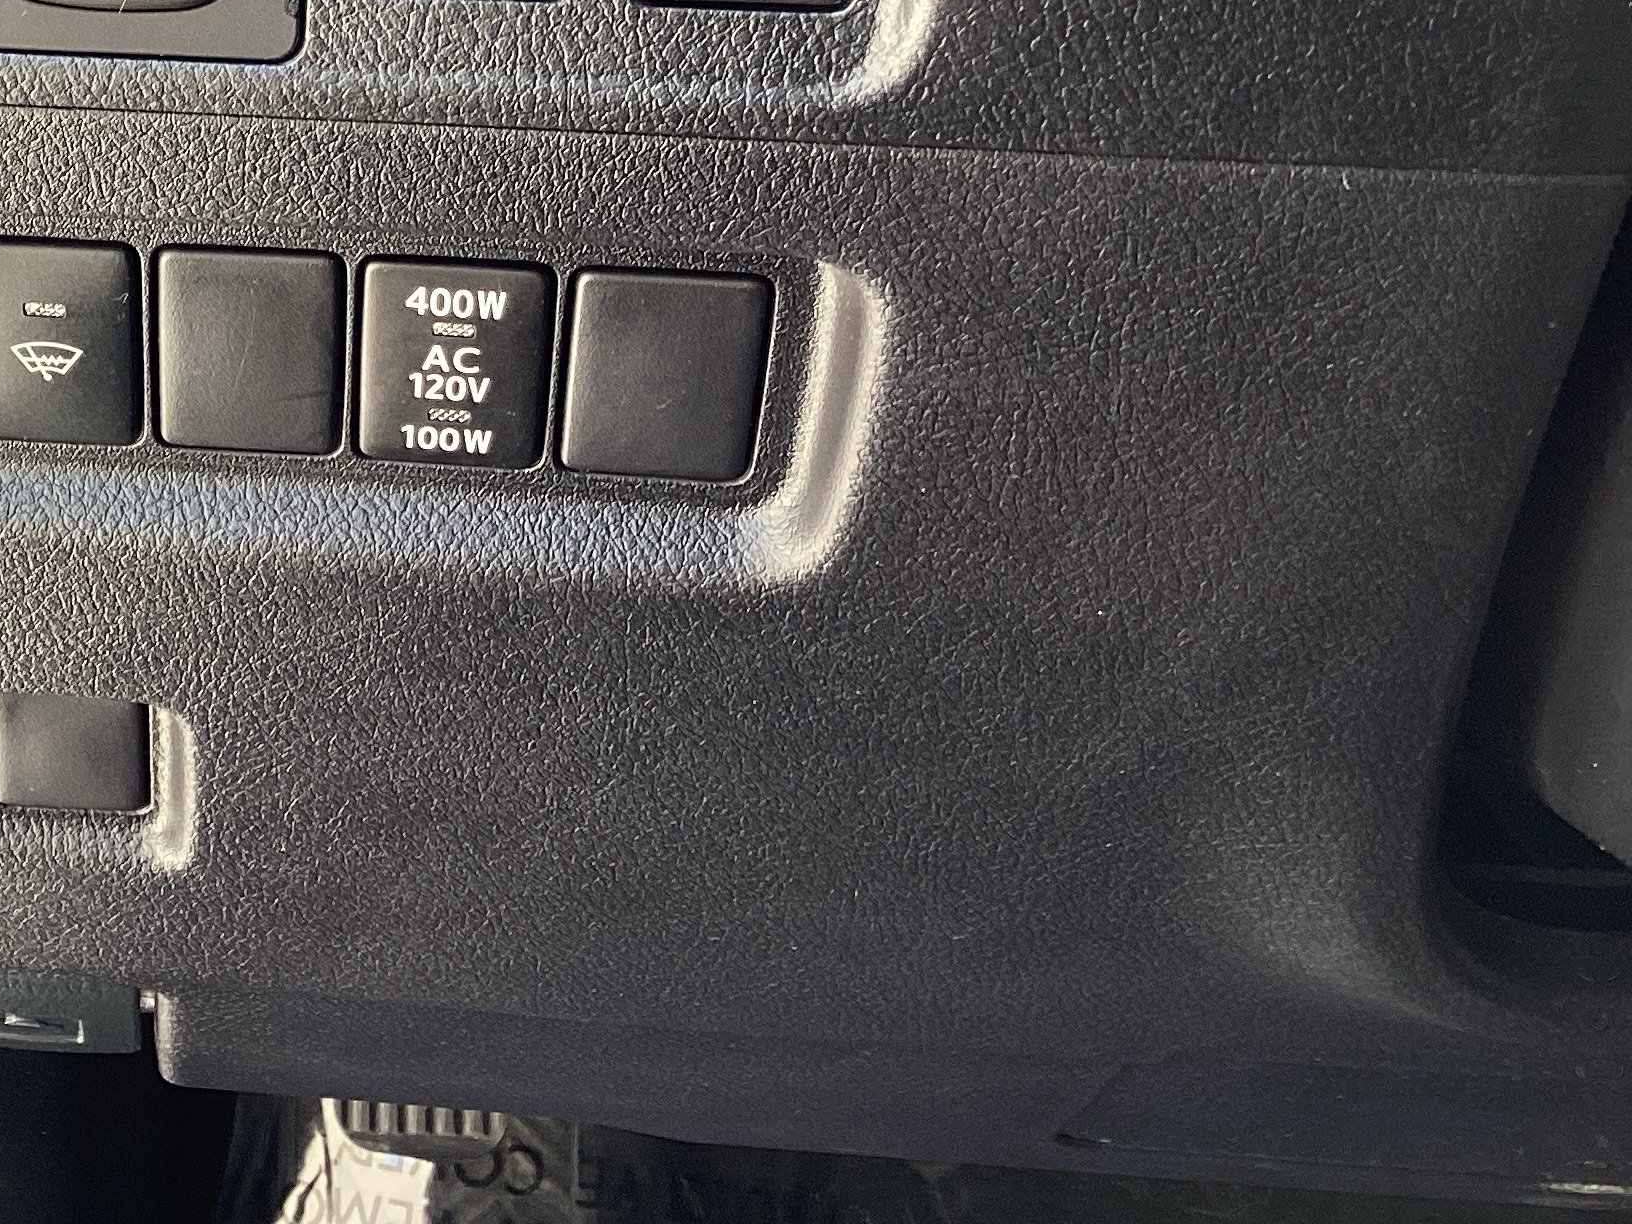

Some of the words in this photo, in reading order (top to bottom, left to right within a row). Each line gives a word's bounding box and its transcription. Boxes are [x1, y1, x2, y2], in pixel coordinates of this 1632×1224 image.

[403, 285, 508, 322] 400W
[420, 343, 482, 375] AC
[407, 371, 492, 405] 120V
[399, 423, 494, 456] 100W
